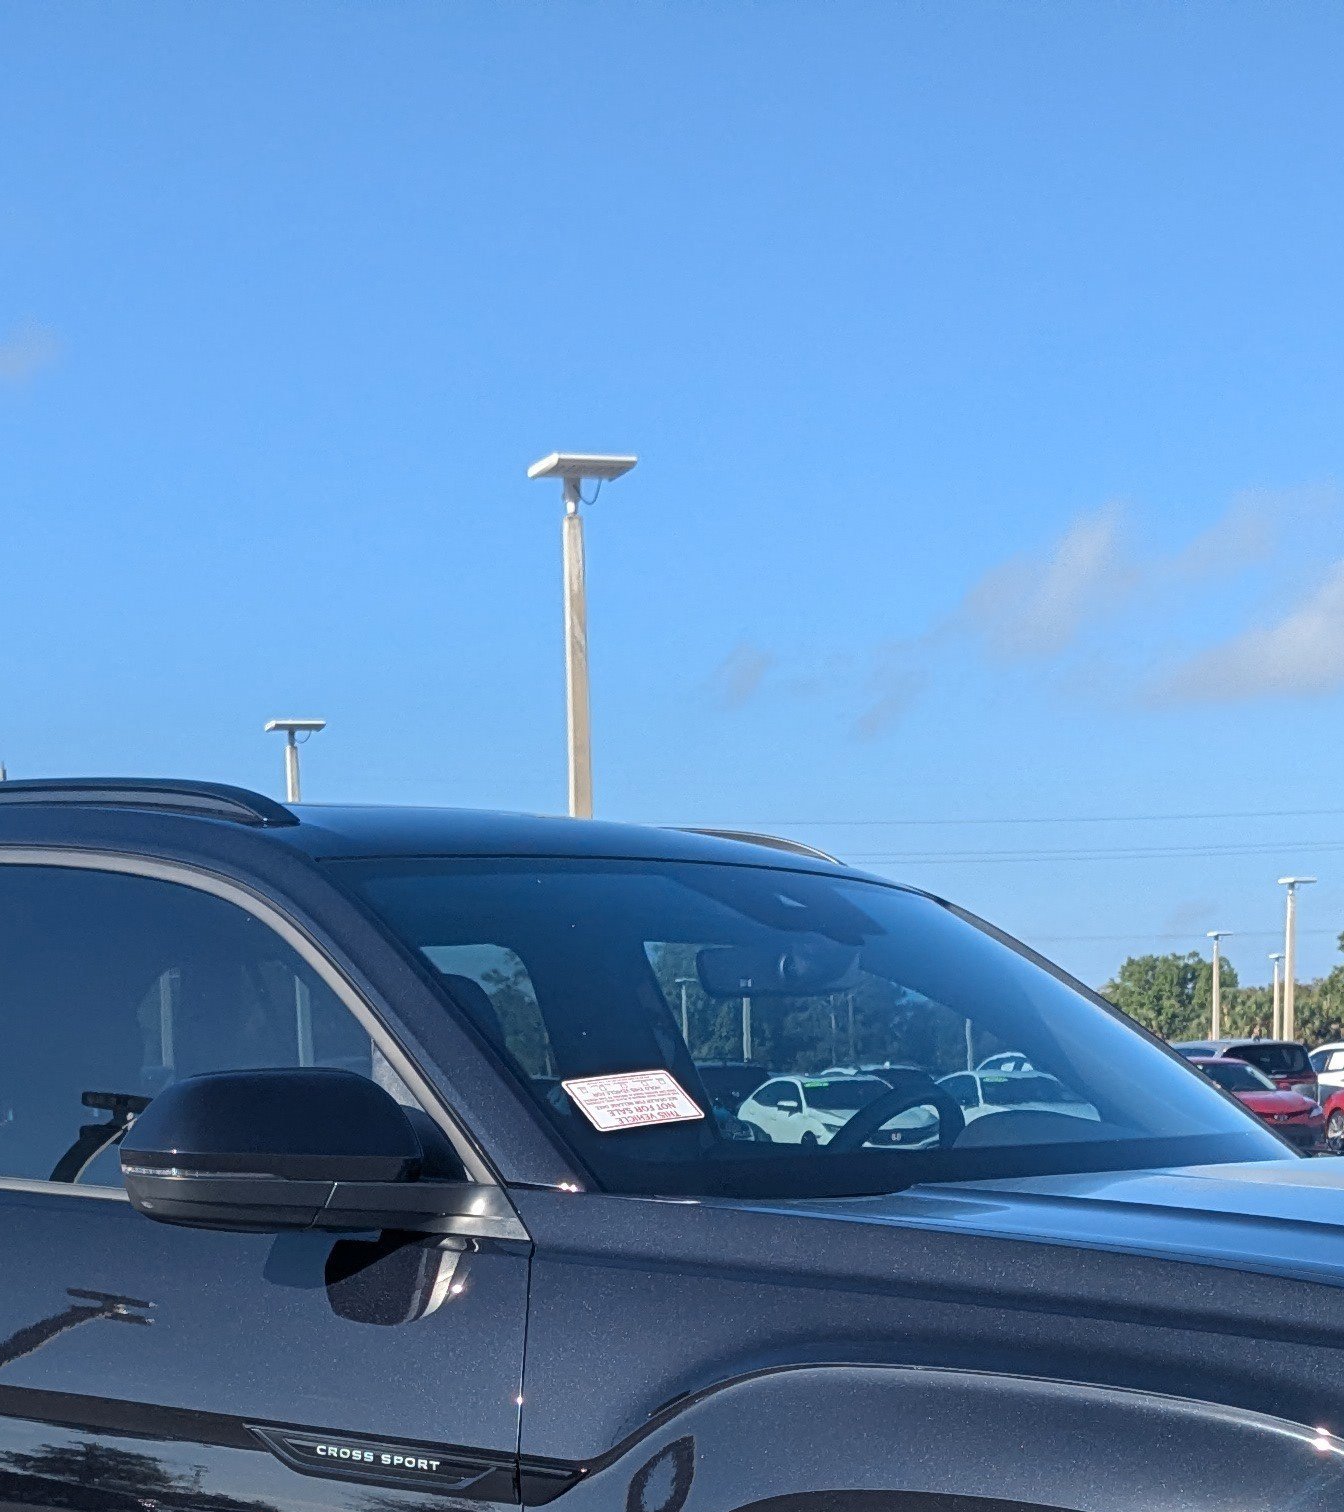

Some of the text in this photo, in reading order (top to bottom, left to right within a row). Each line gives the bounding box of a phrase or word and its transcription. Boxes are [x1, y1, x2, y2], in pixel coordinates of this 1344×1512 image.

[607, 1102, 676, 1117] NOT FOR SALE
[615, 1110, 681, 1125] THIS VEHICLE
[316, 1445, 440, 1471] CROSS SPORT
